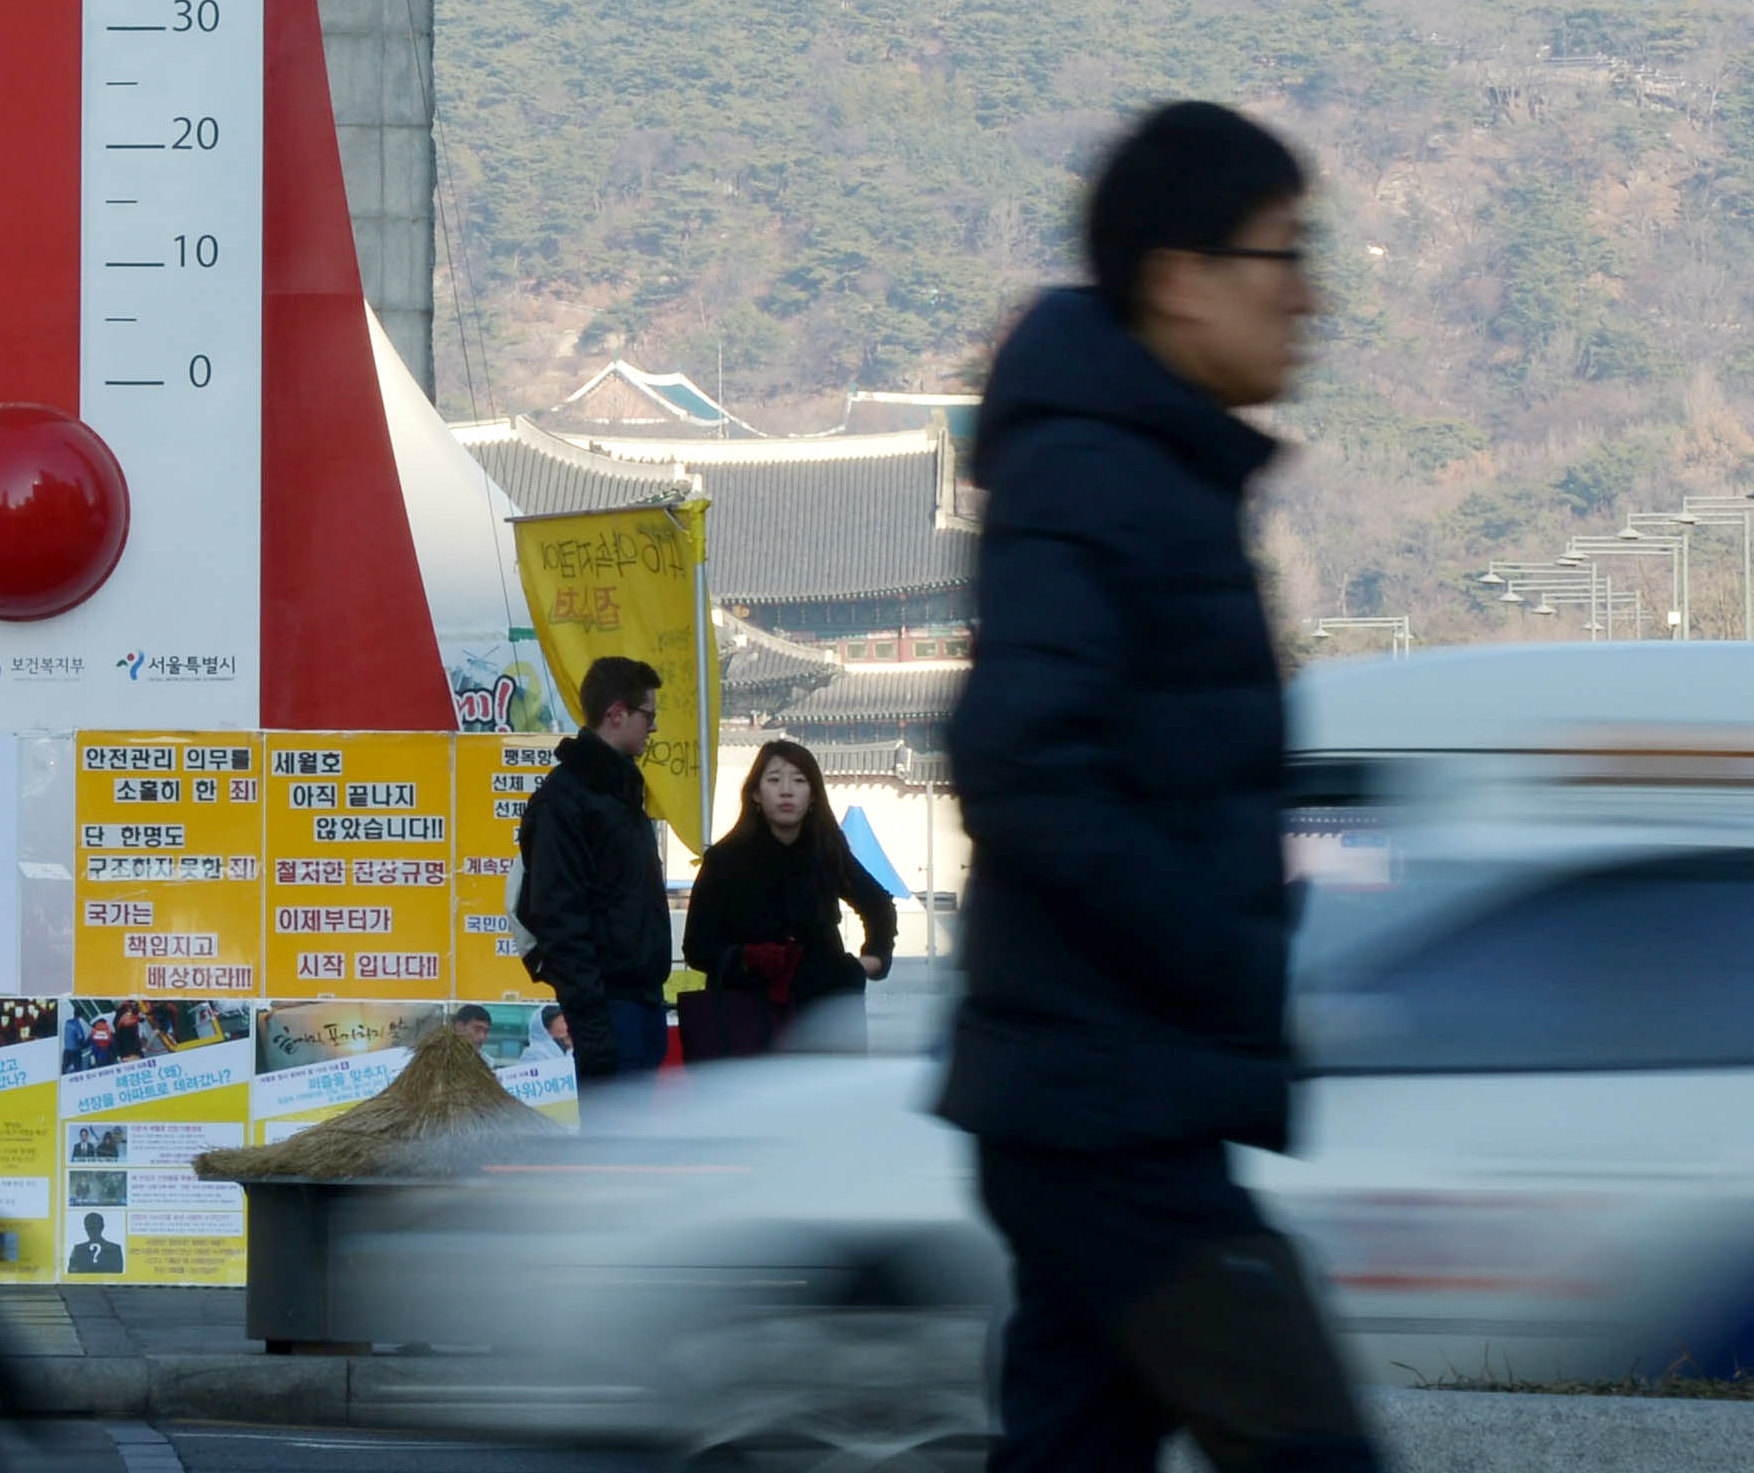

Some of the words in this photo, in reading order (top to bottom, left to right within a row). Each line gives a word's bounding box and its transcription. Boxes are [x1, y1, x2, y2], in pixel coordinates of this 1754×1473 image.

[172, 0, 220, 33] 30
[171, 117, 220, 150] 20
[173, 235, 219, 269] 10
[189, 355, 212, 389] 0
[11, 656, 85, 675] 보건복지부
[148, 655, 236, 675] 서울특별시
[86, 747, 173, 770] 안전관리
[186, 748, 250, 770] 의무를
[274, 752, 341, 774] 세월호
[504, 748, 557, 766] 팽목항
[117, 779, 180, 802] 소홀히
[195, 780, 217, 801] 한
[230, 780, 256, 801] 죄!
[493, 775, 524, 792] 선체
[293, 785, 336, 807] 아직
[348, 784, 415, 807] 끝나지
[85, 826, 104, 847] 단
[121, 826, 184, 848] 한명도
[316, 817, 443, 841] 않았습니다!!
[89, 857, 173, 878] 구조하지
[180, 857, 223, 878] 못한
[277, 861, 343, 884] 철저한
[354, 861, 445, 885] 진상규명
[87, 903, 152, 925] 국가는
[279, 908, 391, 932] 이제부터가
[127, 935, 213, 957] 책임지고
[299, 954, 344, 977] 시작
[358, 955, 438, 977] 입니다!!
[147, 966, 252, 989] 배상하라!!!
